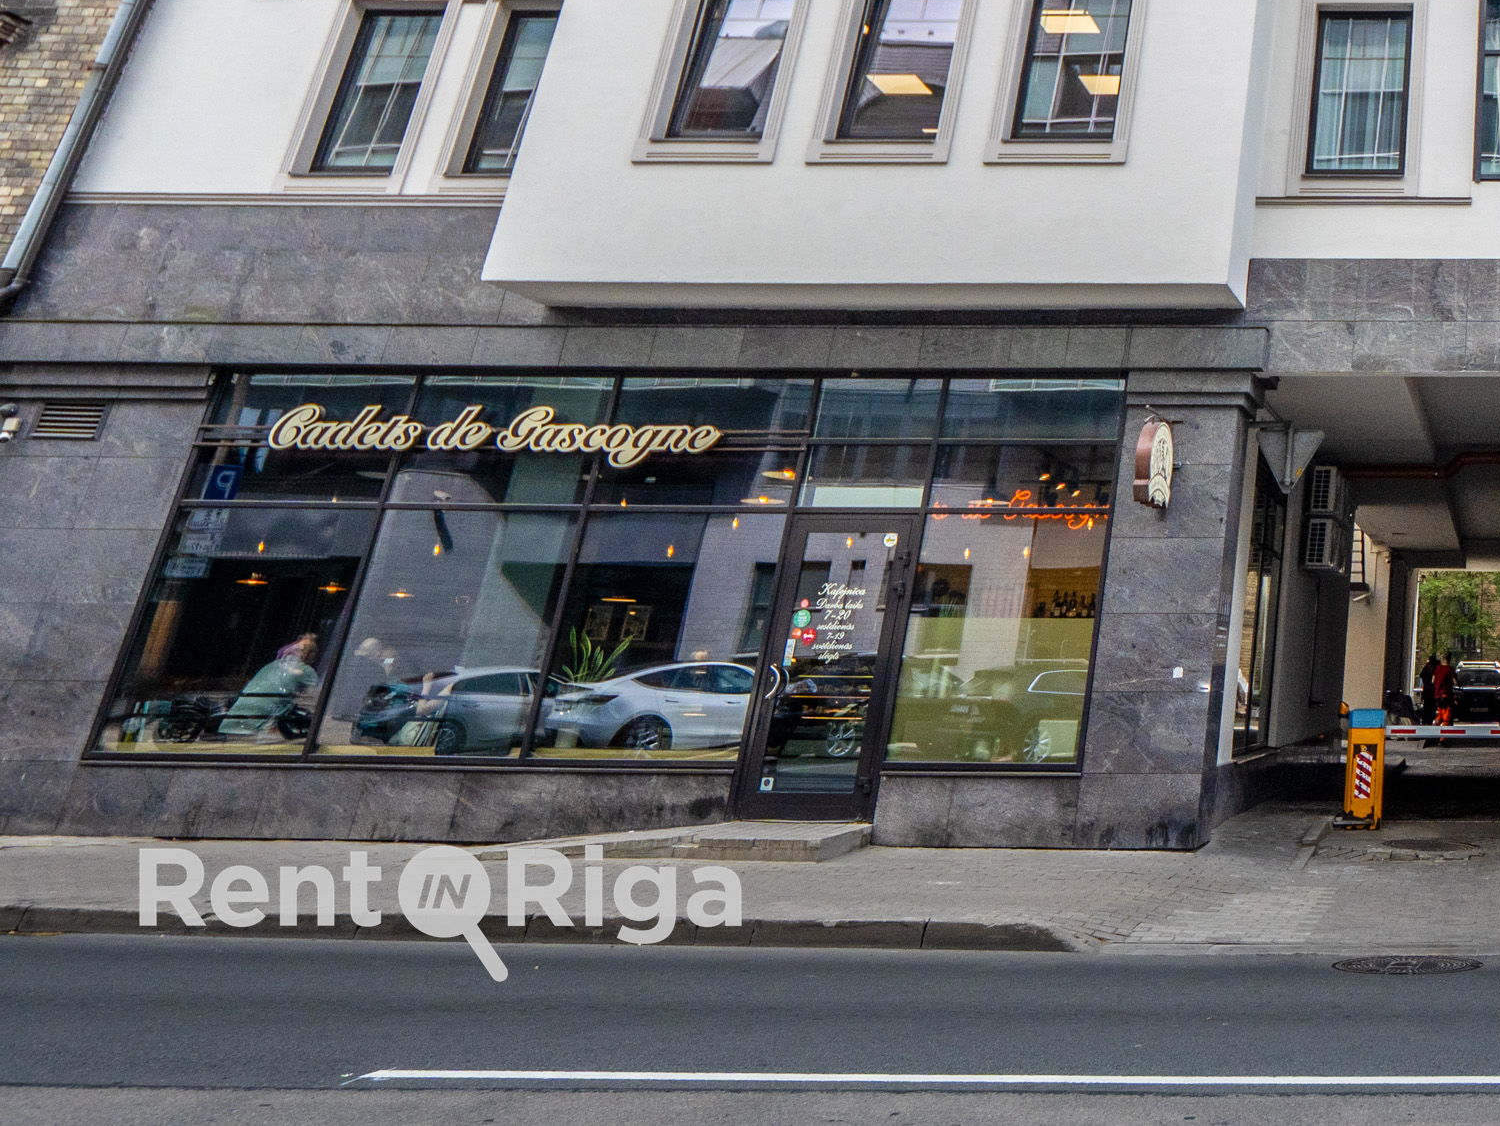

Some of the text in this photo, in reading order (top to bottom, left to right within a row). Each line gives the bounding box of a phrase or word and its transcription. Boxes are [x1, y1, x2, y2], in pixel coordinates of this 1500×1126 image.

[268, 404, 722, 468] Cadets de Gascogne
[818, 582, 866, 599] Kafejnīca
[816, 598, 863, 609] Darba laiks
[824, 610, 851, 620] 7-20
